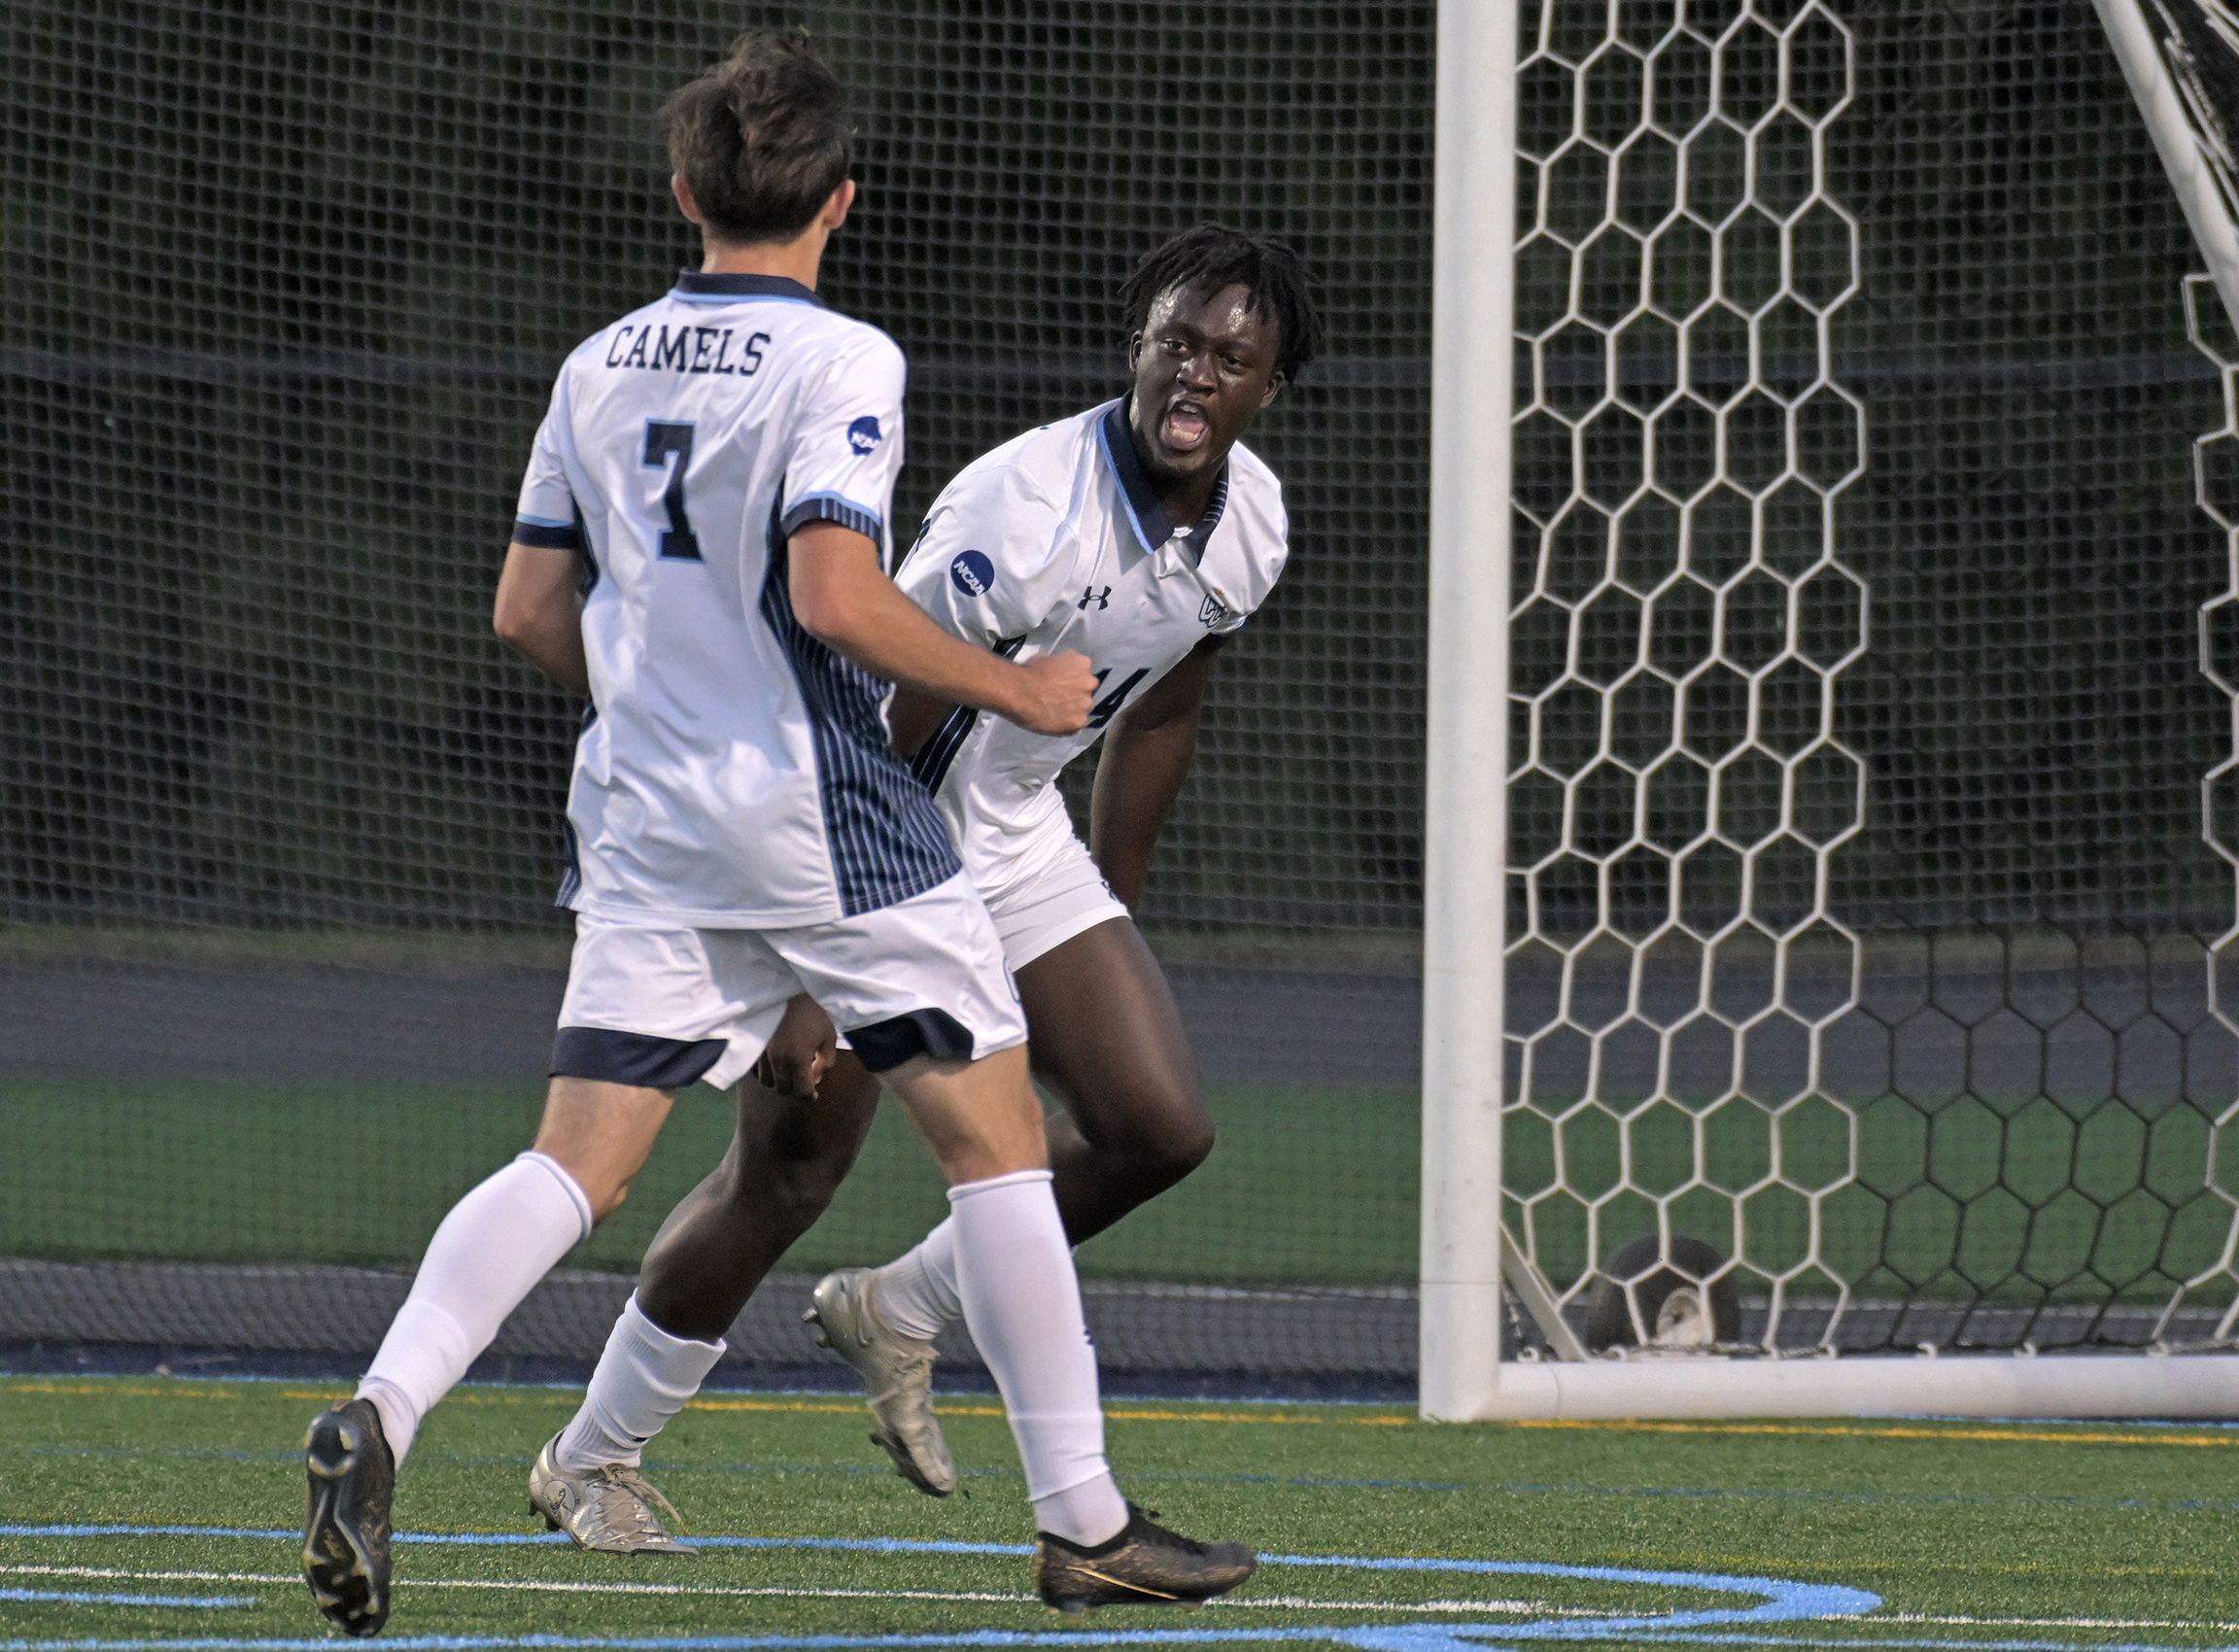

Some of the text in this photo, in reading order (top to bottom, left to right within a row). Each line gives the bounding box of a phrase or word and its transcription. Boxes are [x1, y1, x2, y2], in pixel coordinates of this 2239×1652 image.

[605, 324, 772, 377] CAMELS
[640, 417, 705, 564] 7
[953, 560, 984, 597] NCAA
